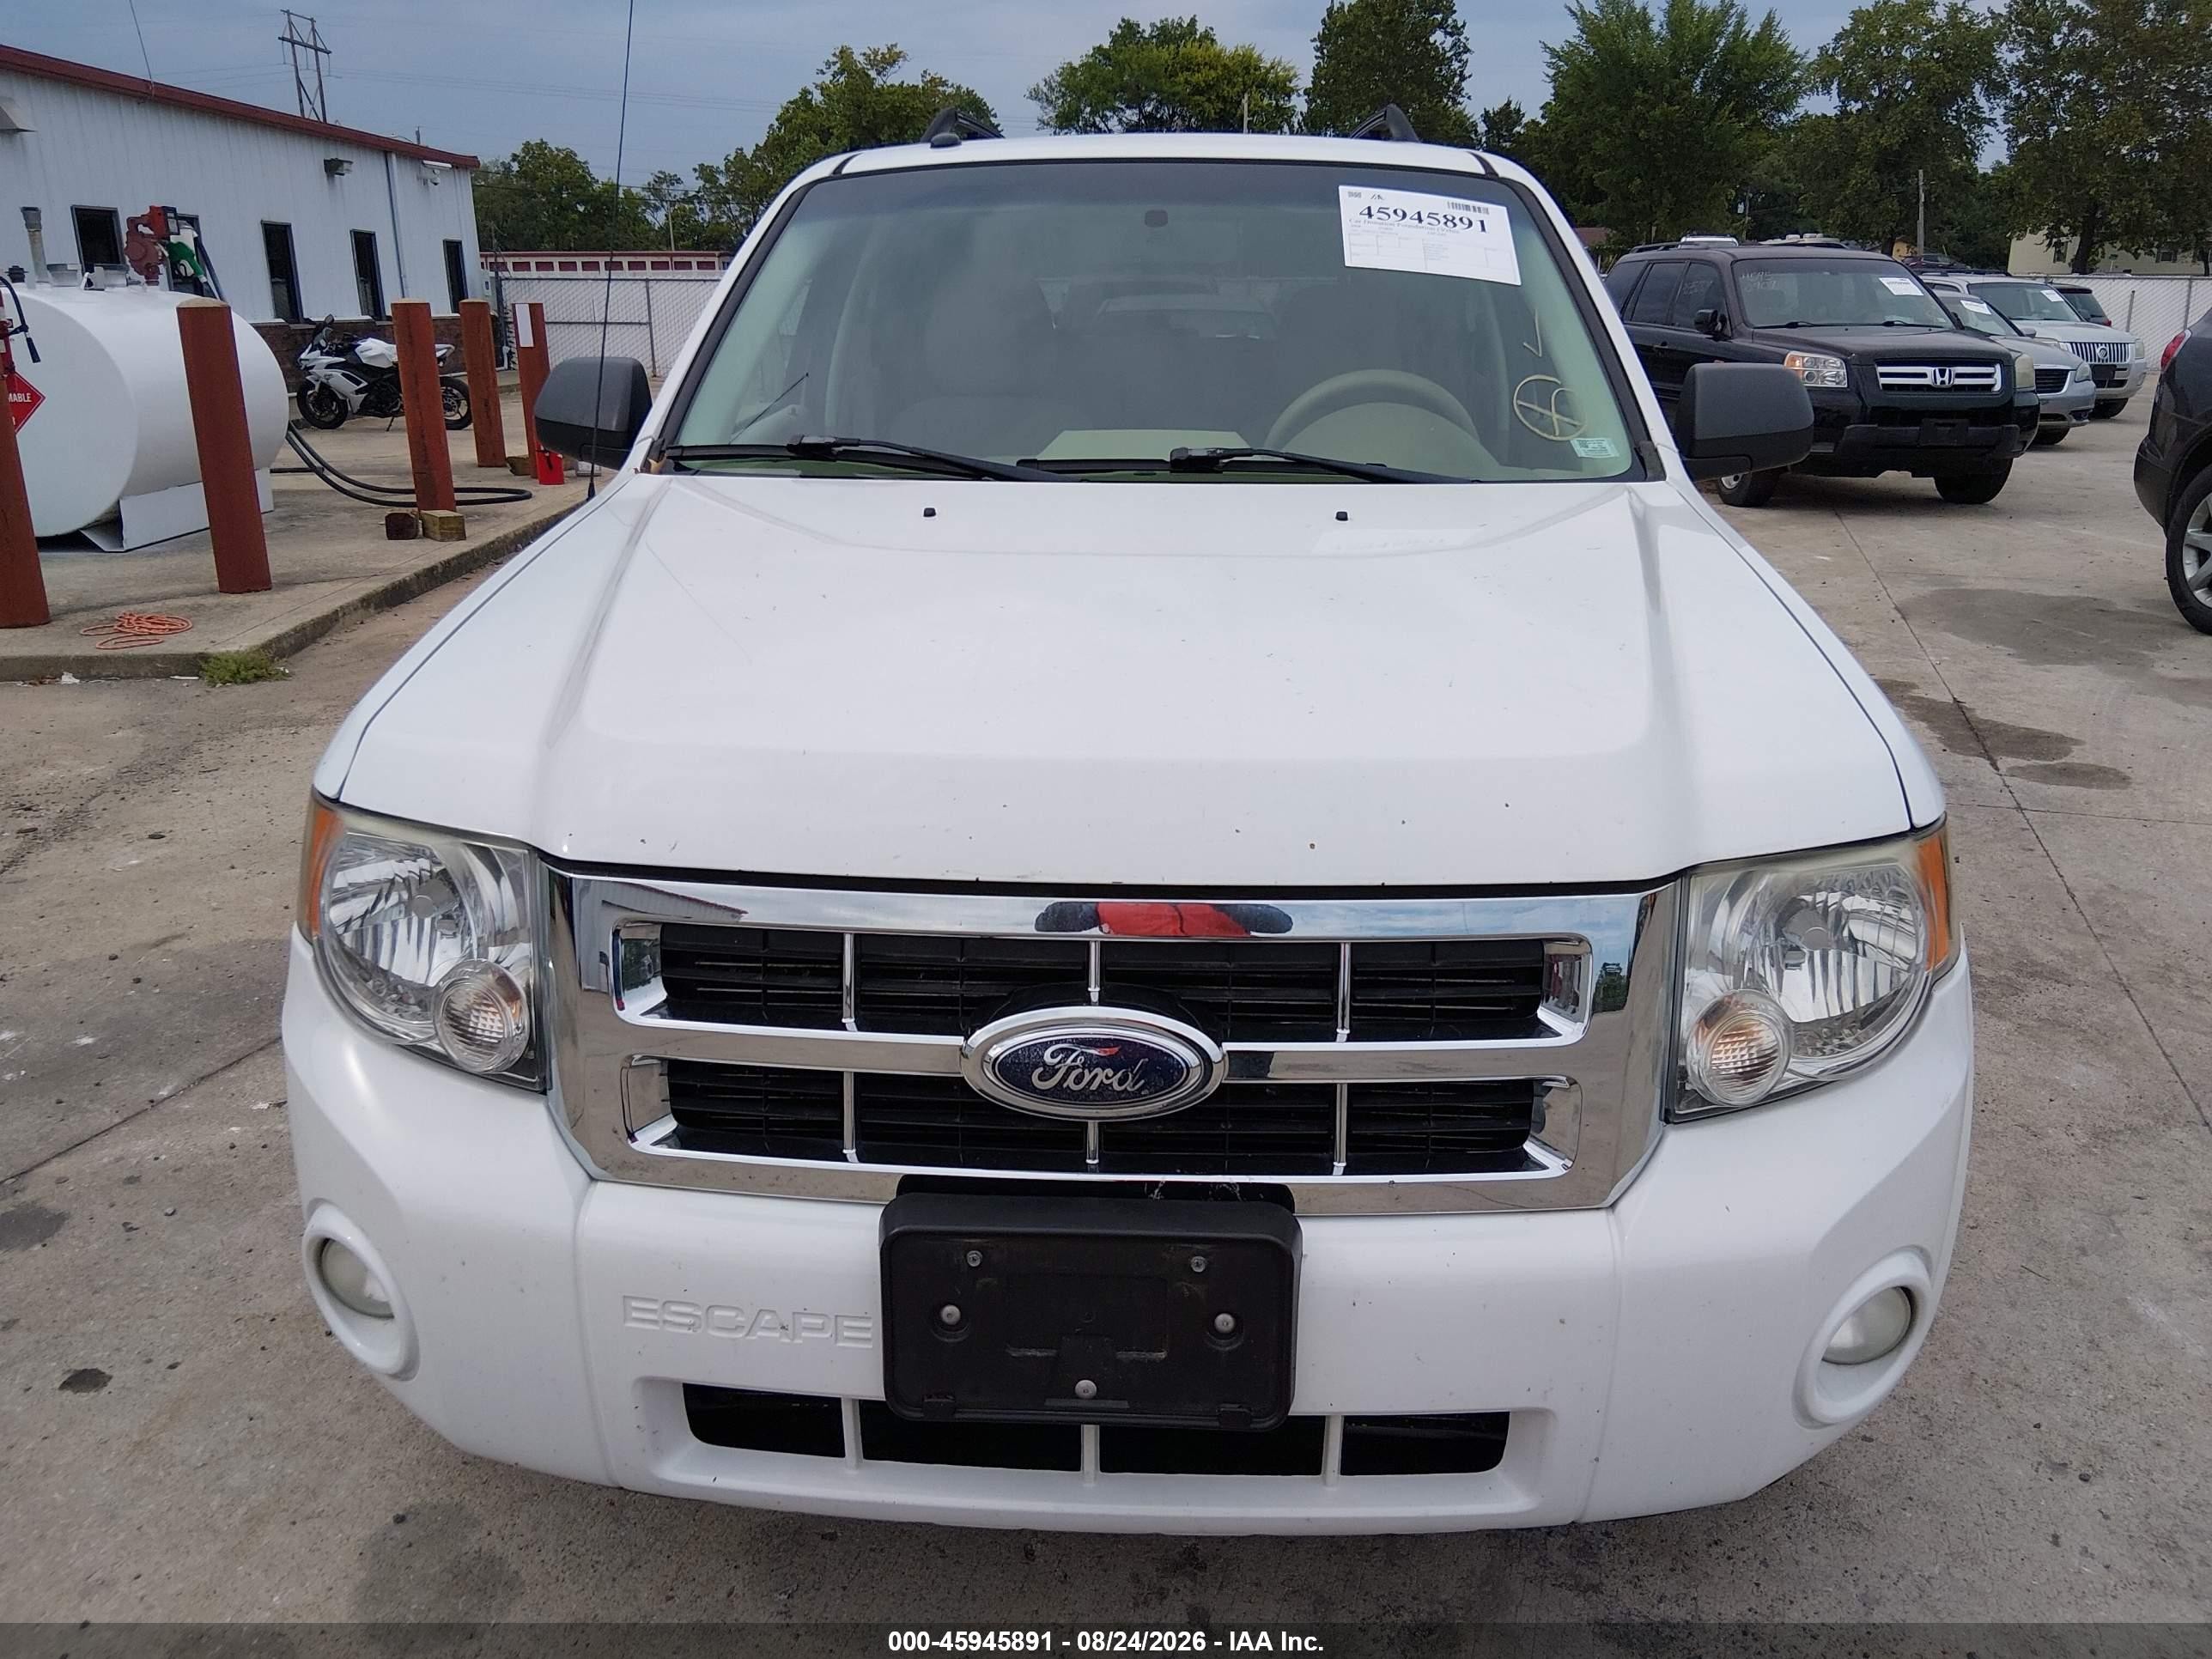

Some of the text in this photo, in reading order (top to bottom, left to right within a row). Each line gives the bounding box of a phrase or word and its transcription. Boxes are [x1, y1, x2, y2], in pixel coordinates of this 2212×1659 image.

[1359, 205, 1487, 234] 45945891
[1031, 1042, 1149, 1091] Ford
[623, 1295, 873, 1348] ESCAPE
